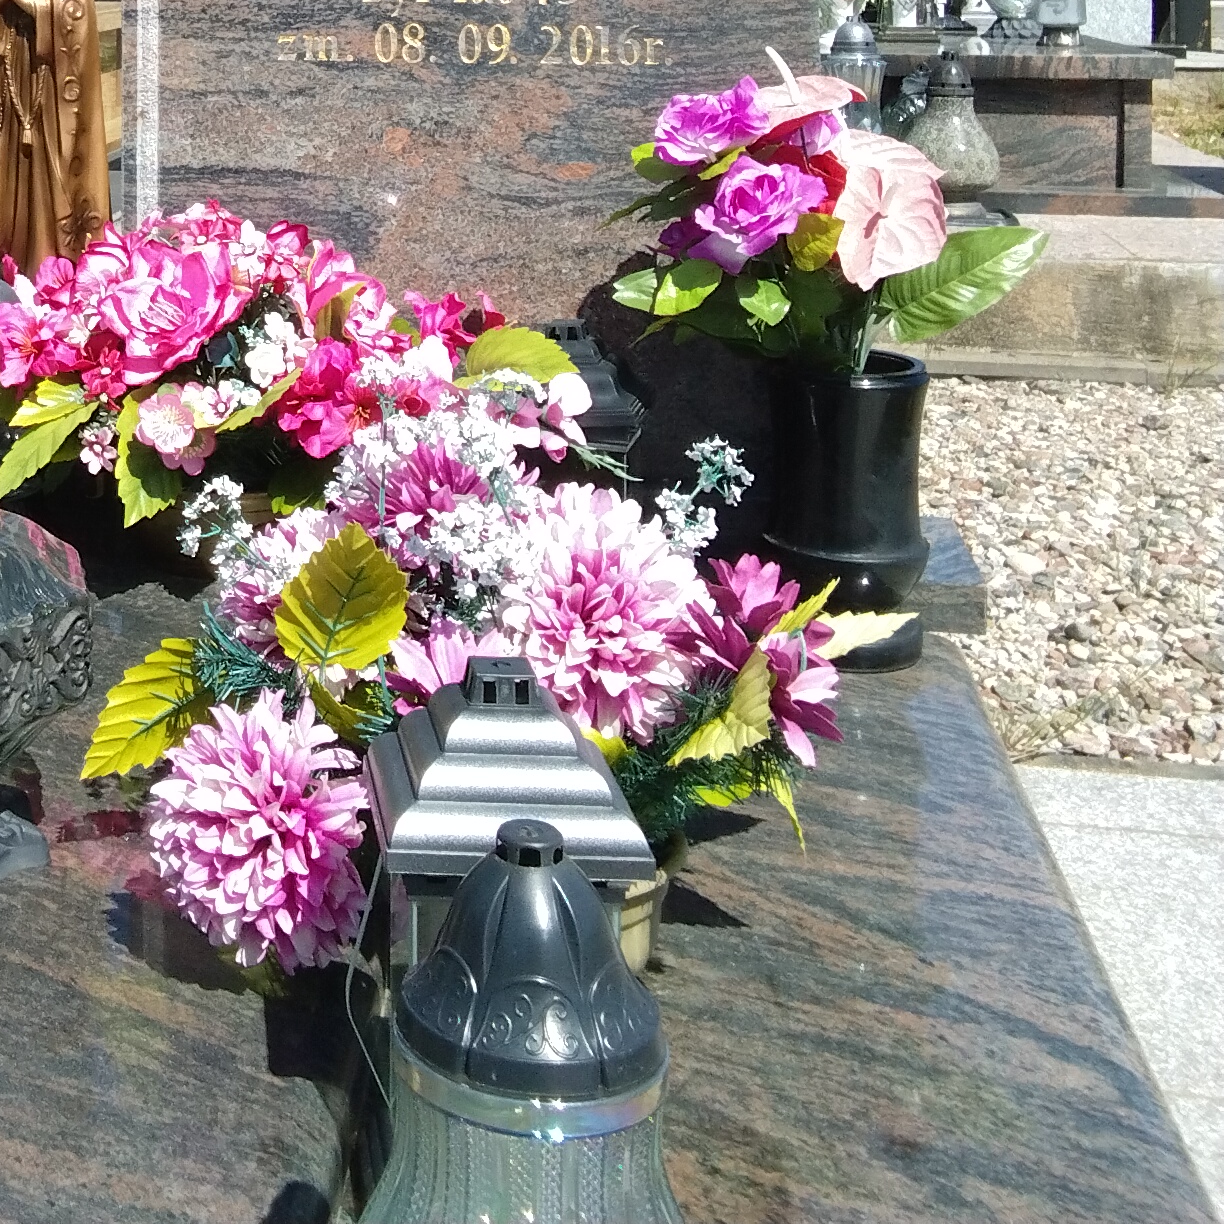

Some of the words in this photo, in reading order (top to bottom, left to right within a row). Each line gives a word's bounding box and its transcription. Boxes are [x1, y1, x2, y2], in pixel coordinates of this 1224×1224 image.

[277, 33, 354, 62] zm.
[374, 23, 436, 64] 08.
[457, 23, 518, 65] 09.
[539, 23, 674, 66] 2016r.
